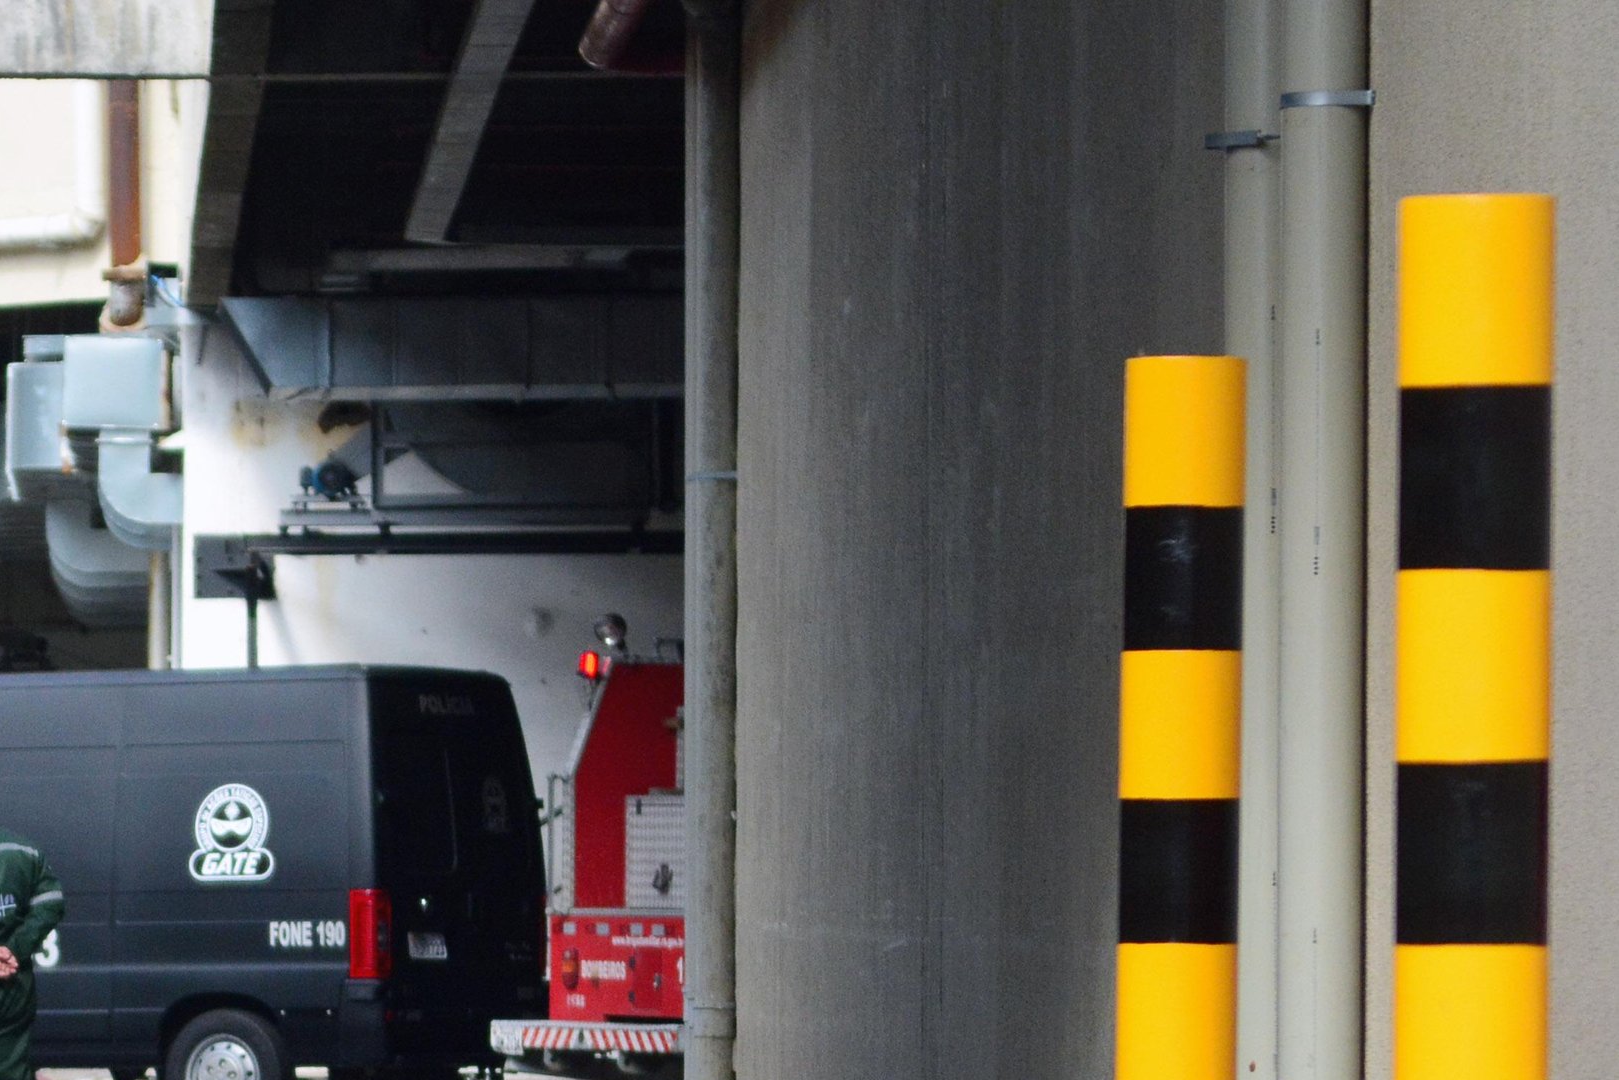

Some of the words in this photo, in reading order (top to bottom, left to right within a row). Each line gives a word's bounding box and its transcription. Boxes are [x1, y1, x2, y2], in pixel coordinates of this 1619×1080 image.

[201, 852, 261, 875] GATE
[269, 921, 314, 947] FONE
[316, 921, 346, 947] 190
